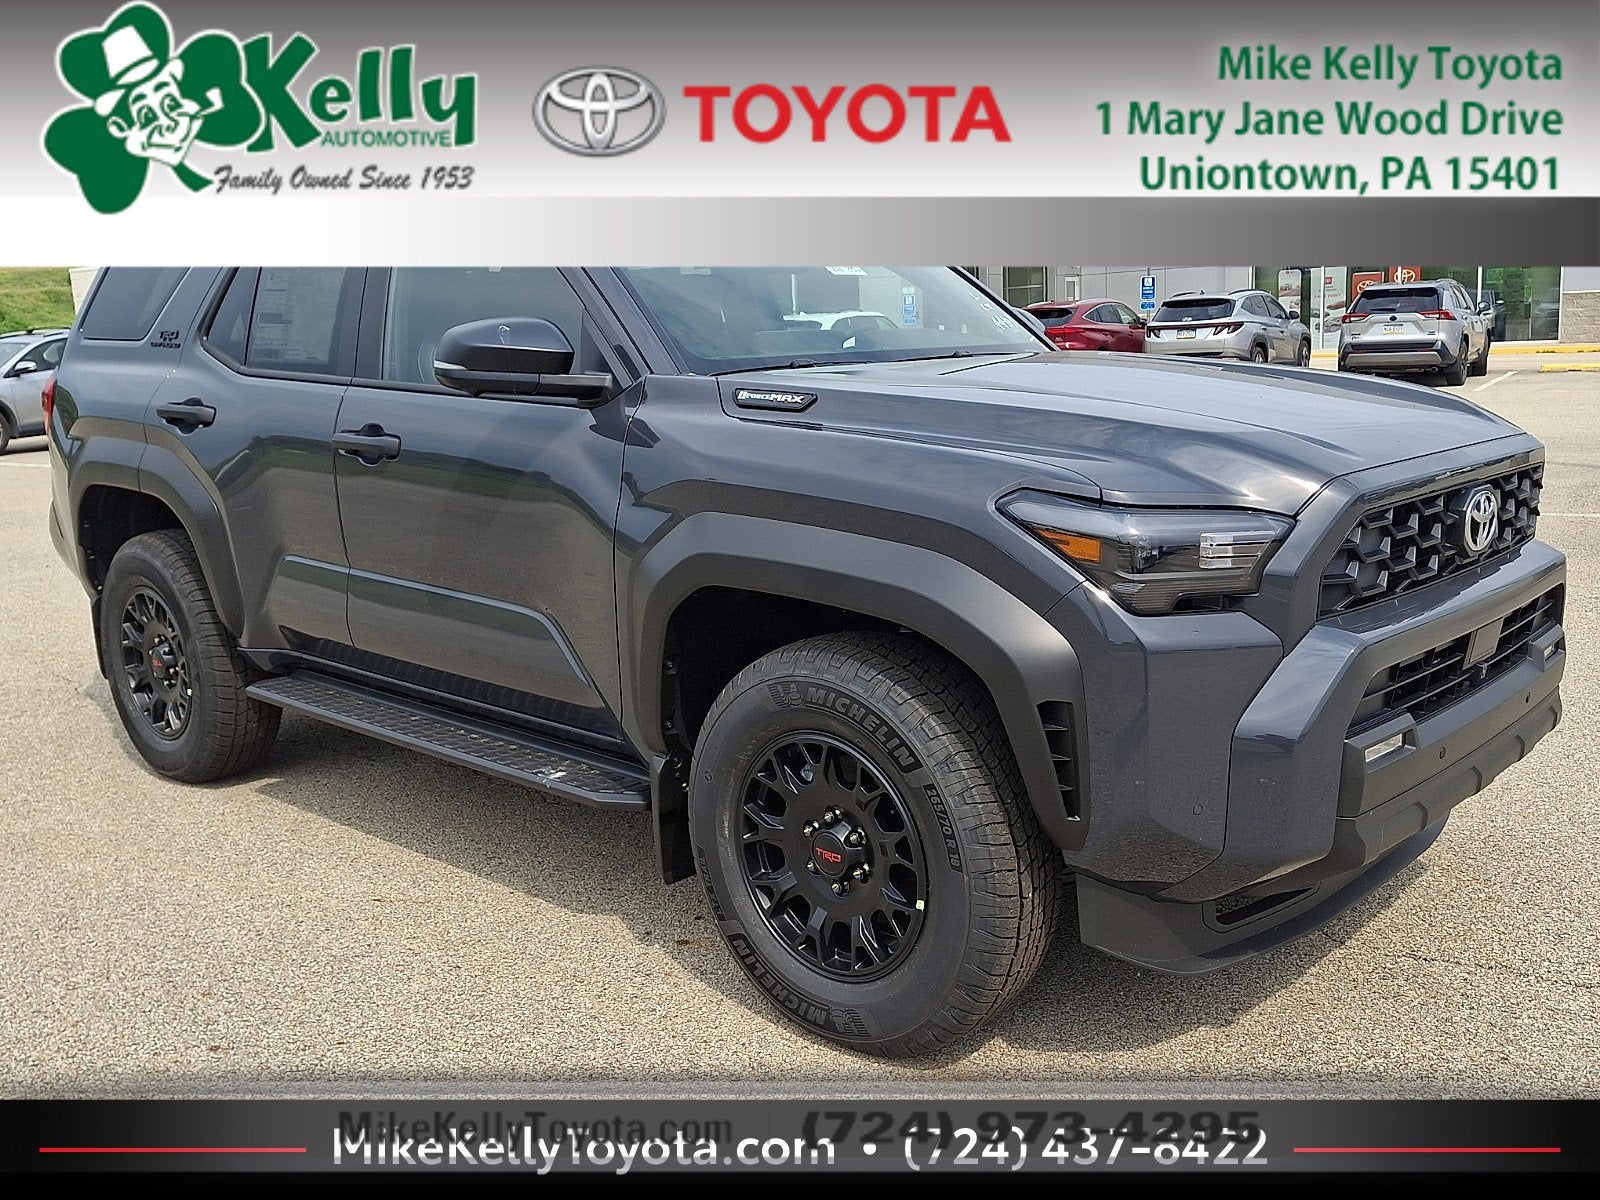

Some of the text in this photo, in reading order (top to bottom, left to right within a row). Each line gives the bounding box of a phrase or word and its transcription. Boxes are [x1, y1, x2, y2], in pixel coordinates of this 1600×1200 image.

[806, 686, 915, 767] MICHELIN
[815, 846, 842, 863] TRD
[926, 788, 953, 836] 265/70
[945, 838, 957, 850] R
[731, 938, 828, 1026] MICHELIN
